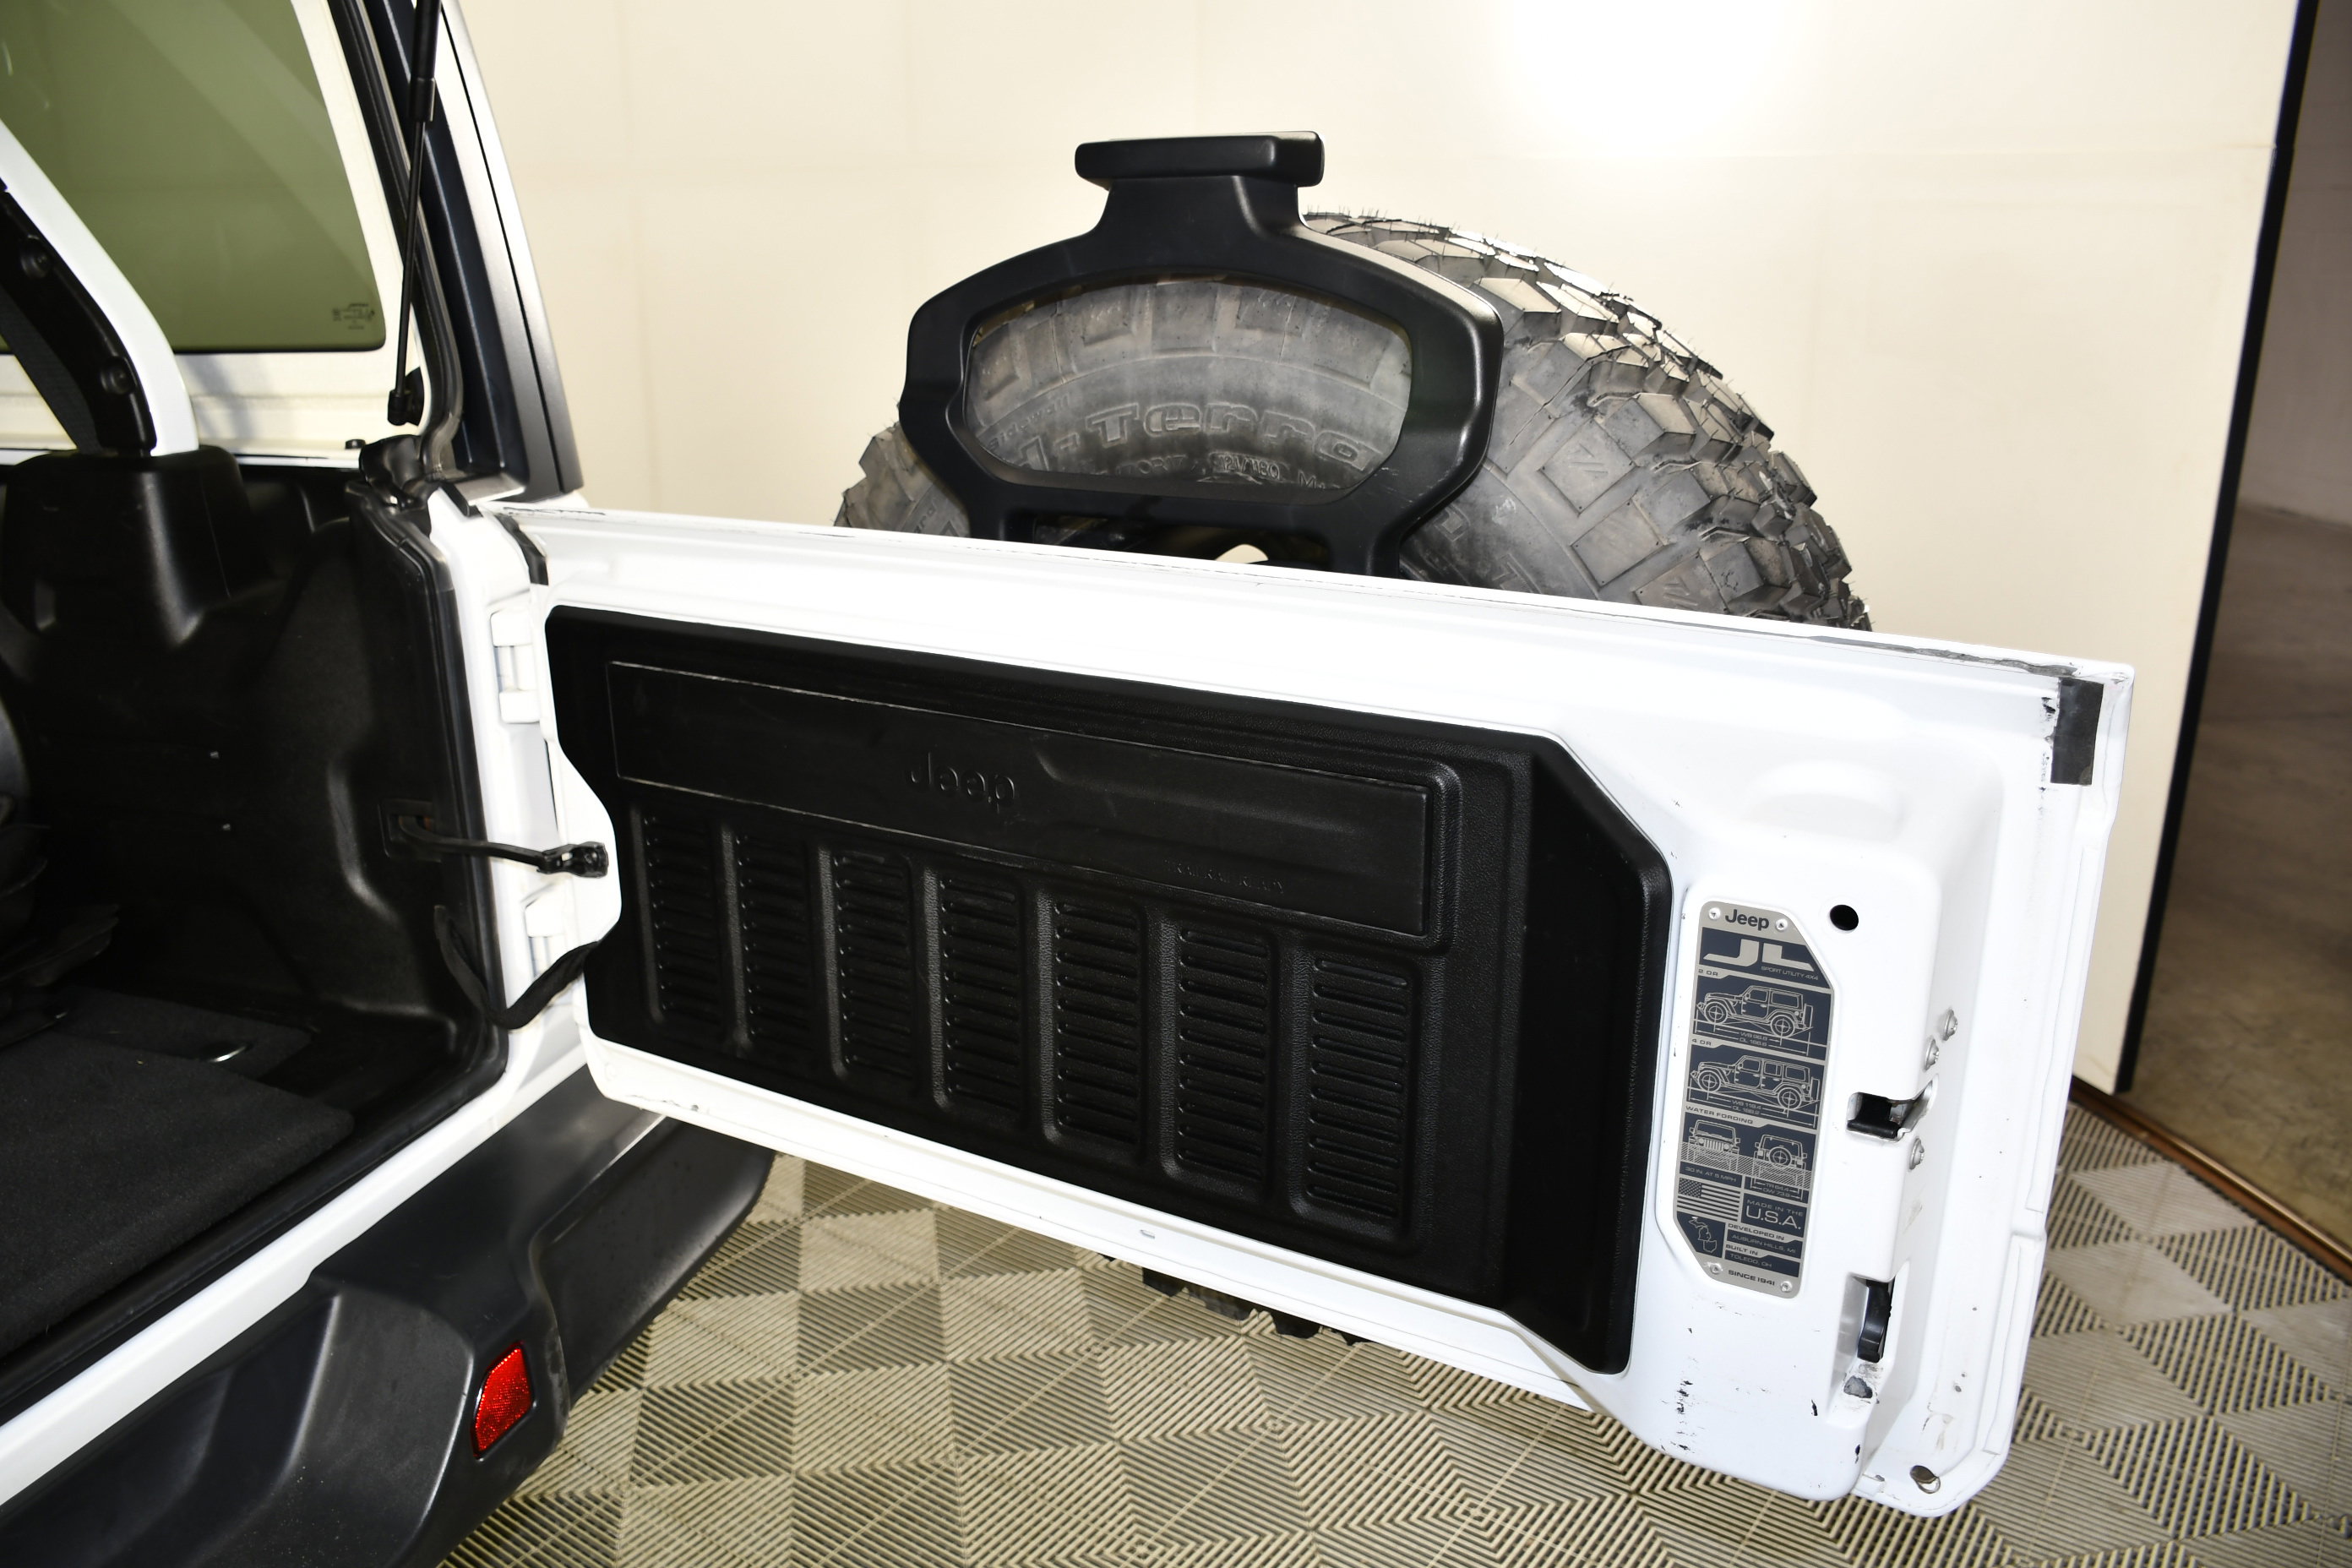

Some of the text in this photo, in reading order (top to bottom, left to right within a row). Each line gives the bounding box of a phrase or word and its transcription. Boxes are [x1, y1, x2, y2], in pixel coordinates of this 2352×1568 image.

[908, 752, 1015, 814] Jeep
[1724, 909, 1770, 931] Jeep
[1703, 939, 1815, 972] JL
[1782, 969, 1805, 978] UTILITY
[1685, 1105, 1754, 1124] WATER FORDING
[1720, 1173, 1737, 1182] MPH
[1746, 1199, 1772, 1209] MADE
[1786, 1208, 1805, 1217] THE
[1745, 1205, 1801, 1230] U.S.A.
[1728, 1222, 1775, 1239] DEVELOPED
[1731, 1234, 1763, 1245] AUBURN
[1725, 1244, 1748, 1253] BUILT
[1728, 1270, 1775, 1286] SINCE 1941
